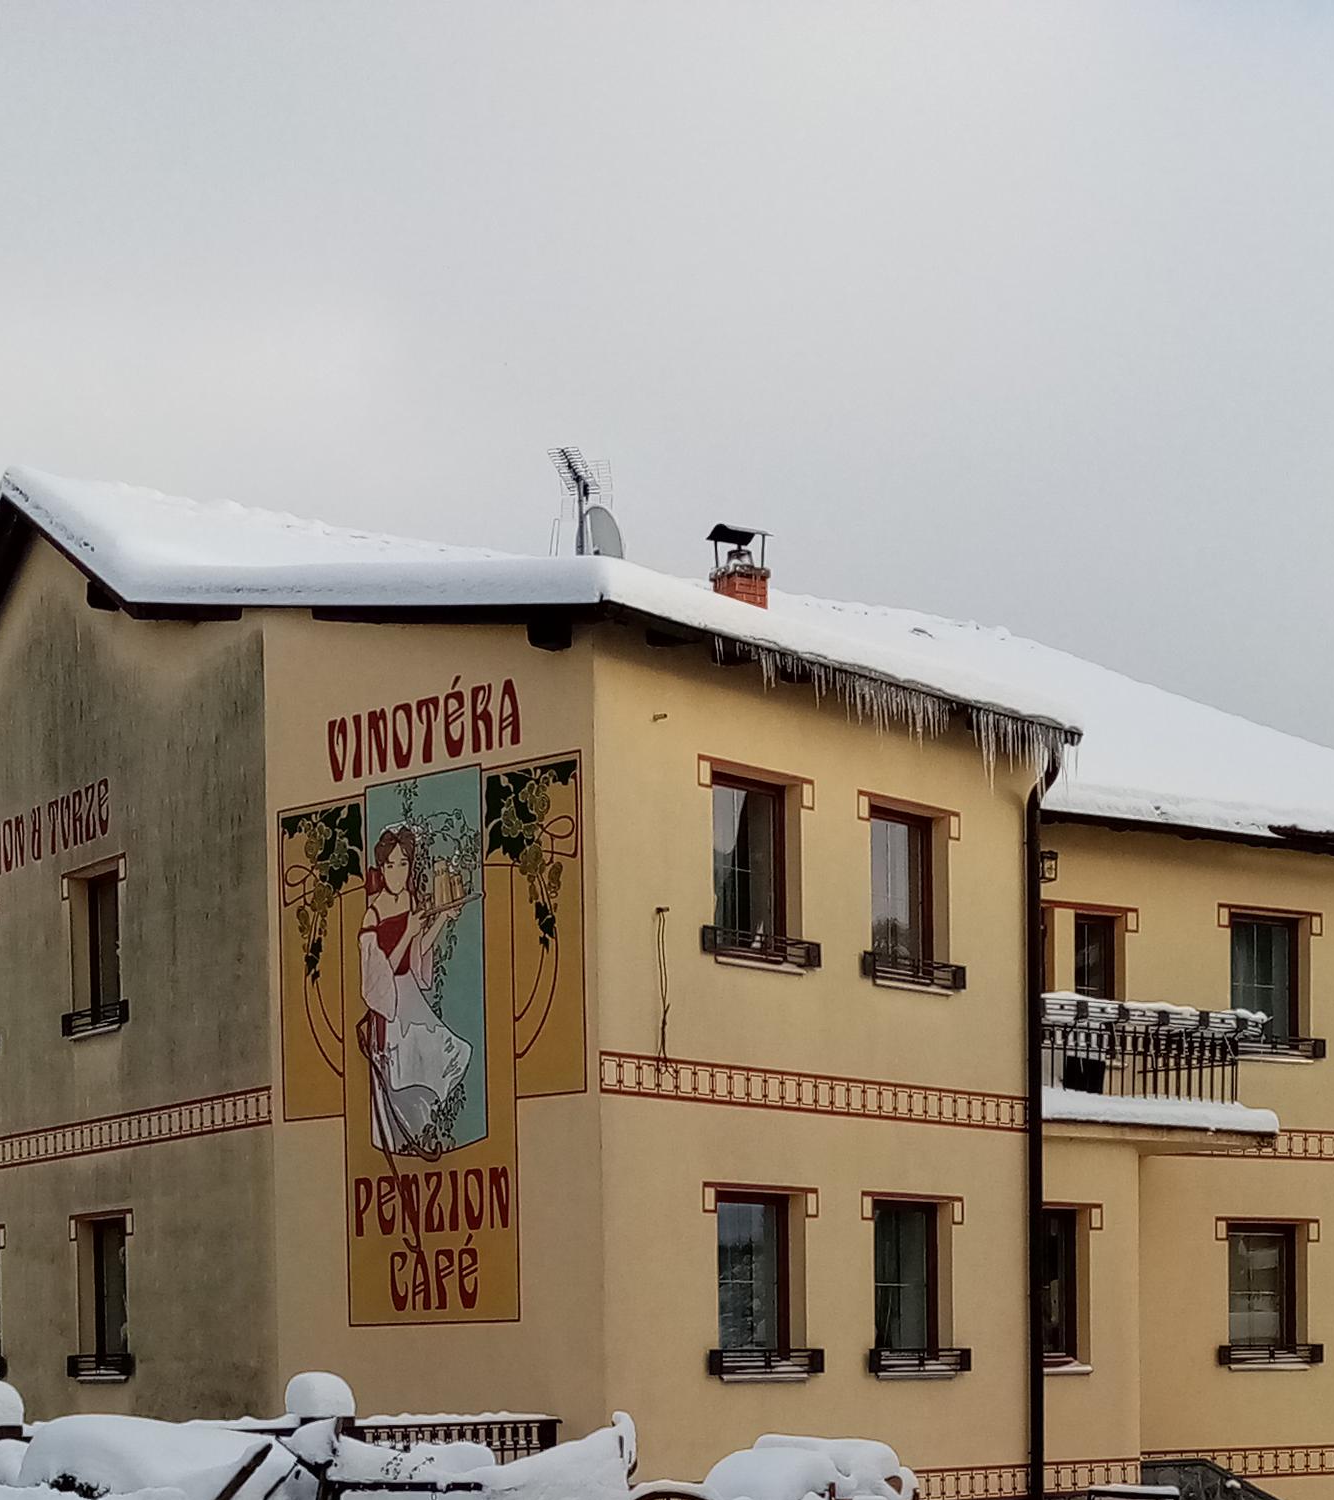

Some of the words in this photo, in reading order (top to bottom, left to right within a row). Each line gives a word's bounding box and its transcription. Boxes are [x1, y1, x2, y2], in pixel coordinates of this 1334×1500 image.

[327, 675, 521, 782] VINOTÉKA
[354, 1165, 510, 1237] PENZION
[390, 1233, 478, 1312] CAFÉ
